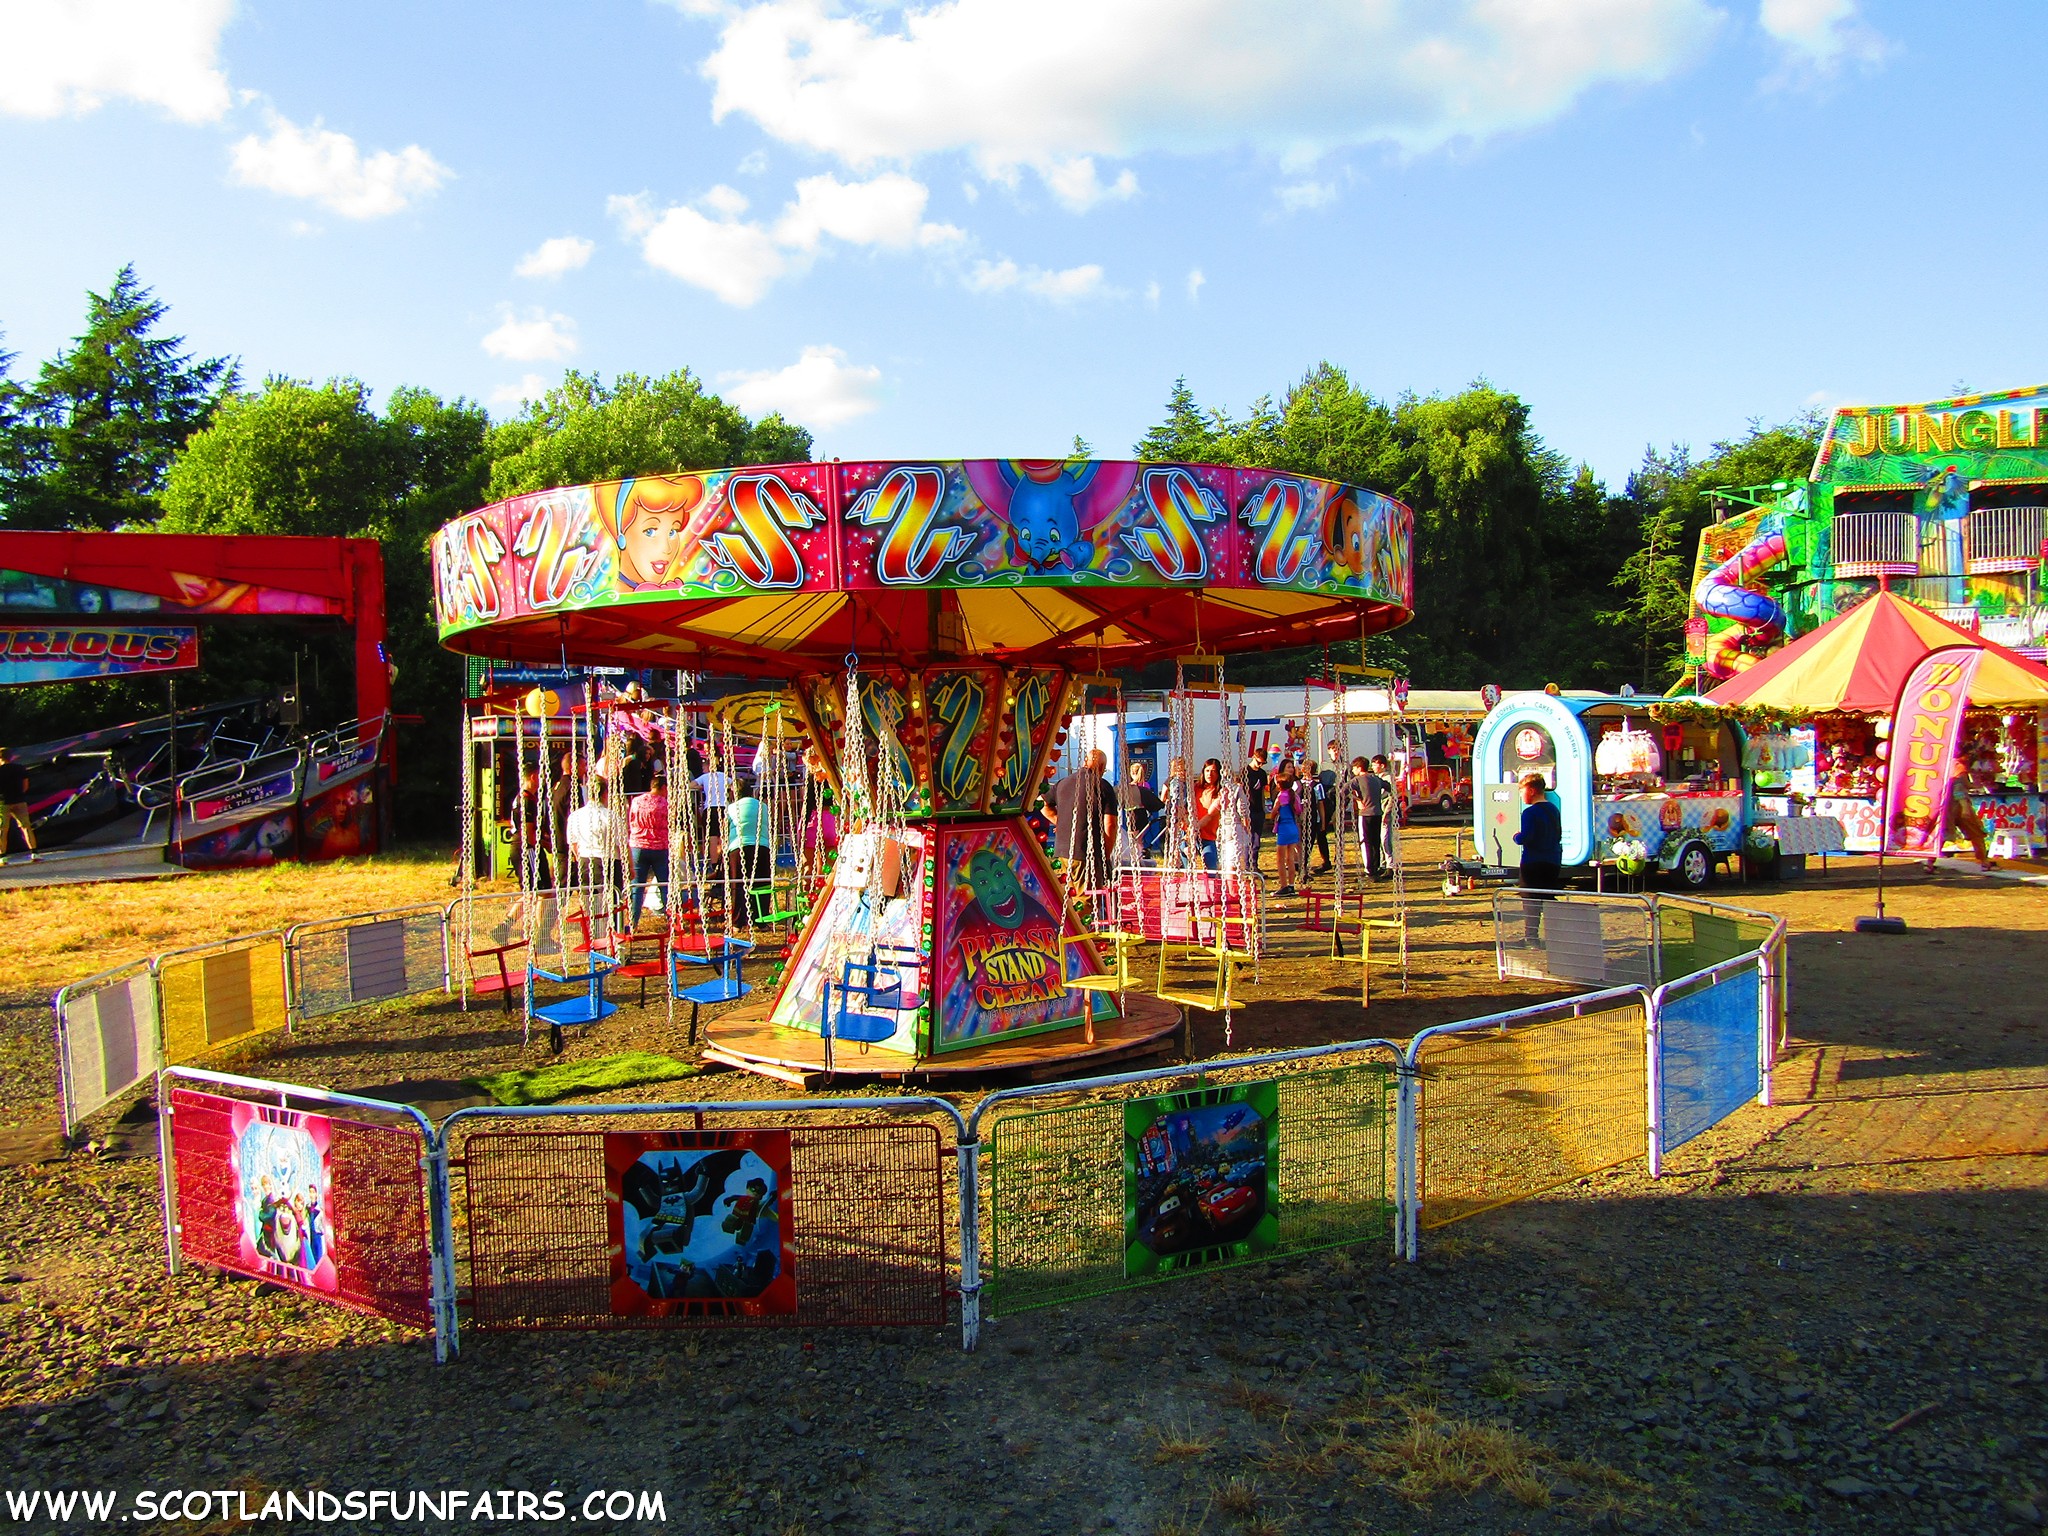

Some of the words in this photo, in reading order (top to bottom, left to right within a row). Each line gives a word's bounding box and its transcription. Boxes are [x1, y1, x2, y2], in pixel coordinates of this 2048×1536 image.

[0, 630, 178, 665] RIOUS
[1495, 702, 1516, 719] COFFEE
[1534, 701, 1554, 715] CAKES
[1475, 730, 1488, 760] DONUTS
[1563, 725, 1579, 759] PASTRIES
[1904, 663, 1962, 819] DONUTS
[212, 804, 233, 815] FEEL
[236, 797, 252, 806] THE
[224, 793, 243, 802] CAN
[245, 785, 263, 795] YOU
[1978, 797, 2027, 819] Hook
[1838, 801, 1882, 820] Hoo
[959, 927, 1061, 981] PLEASE
[985, 952, 1046, 985] STAND
[975, 974, 1067, 1010] CLEAR
